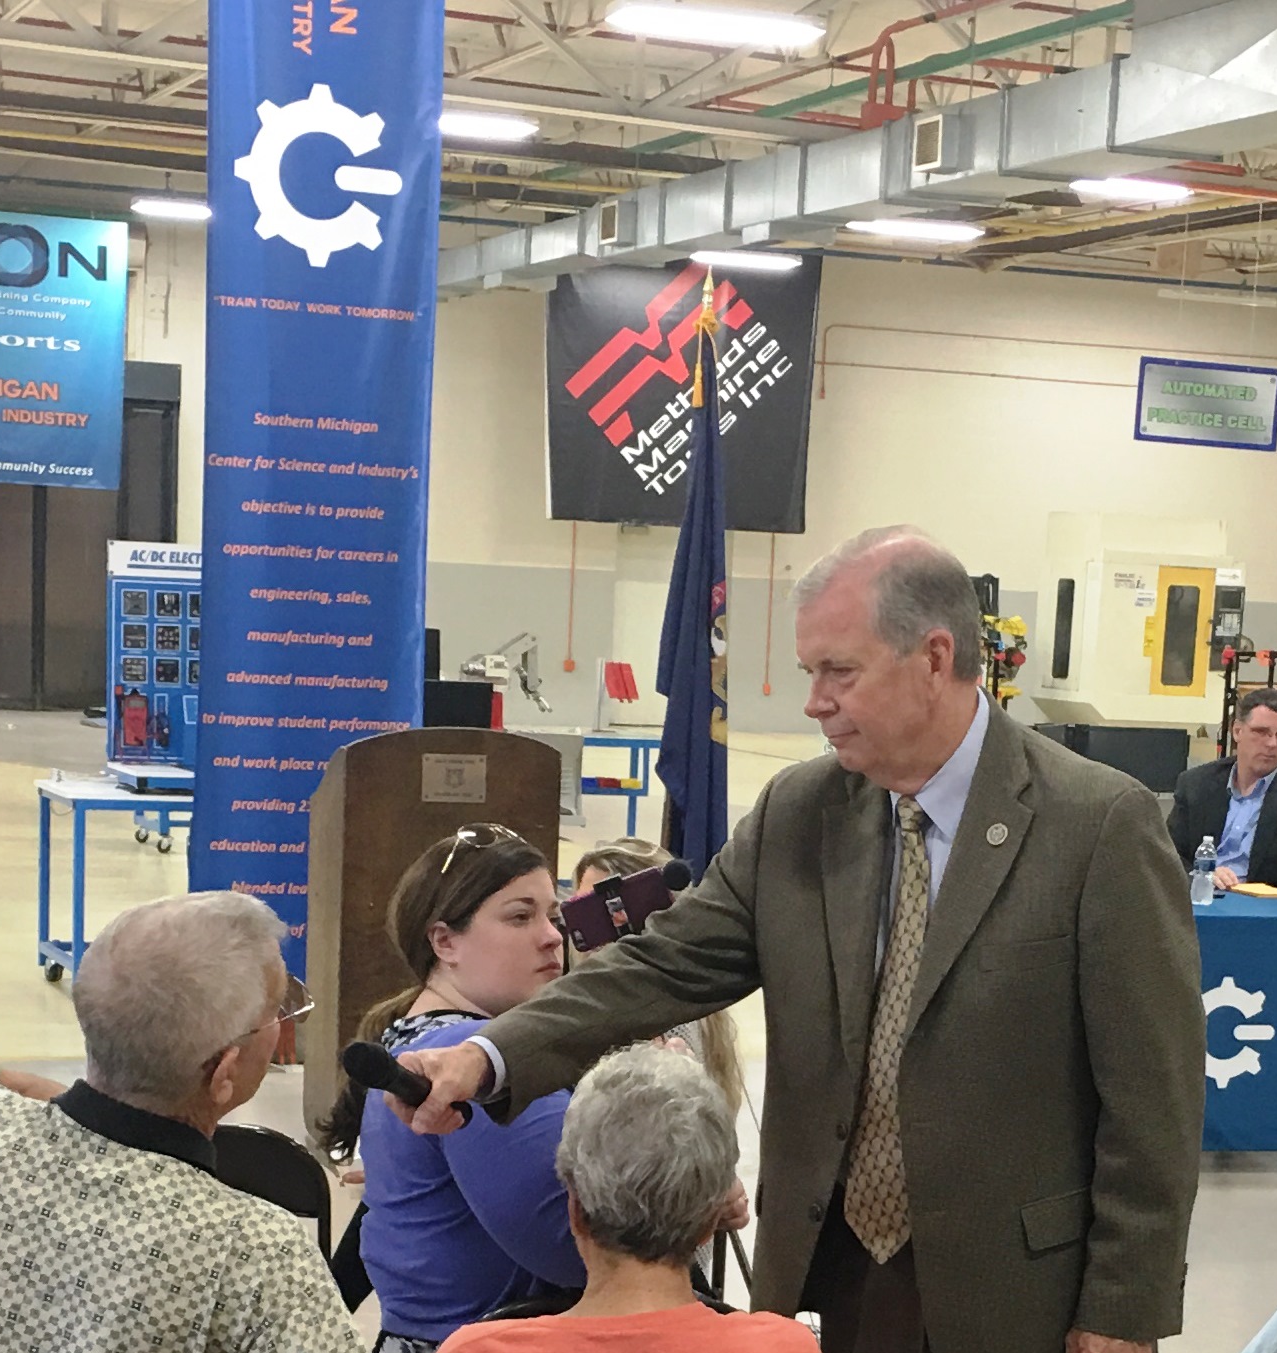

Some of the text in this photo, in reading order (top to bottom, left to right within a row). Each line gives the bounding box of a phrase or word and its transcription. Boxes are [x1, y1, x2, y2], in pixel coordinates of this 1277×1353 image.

[33, 293, 92, 308] Company
[307, 302, 342, 316] WORK
[620, 322, 767, 464] Methds
[1161, 380, 1258, 401] AUTOMATED
[2, 408, 89, 428] INDUSTRY
[634, 338, 780, 482] Maine
[1146, 406, 1267, 432] PRACTICE CELL
[253, 412, 379, 435] Southern Michigan
[644, 355, 793, 495] Tos Inc
[48, 462, 93, 477] Success
[207, 453, 252, 468] Center
[254, 455, 276, 471] for
[278, 457, 326, 473] Science
[329, 462, 354, 475] and
[241, 499, 385, 520] objective is to provide
[130, 549, 166, 564] AC/DC
[222, 543, 399, 563] opportunities for careers in
[249, 587, 372, 605] engineering, sales,
[247, 630, 373, 648] manufacturing and
[226, 671, 388, 692] advanced manufacturing
[202, 712, 410, 733] to improve student performance
[213, 755, 240, 768] and
[243, 755, 277, 769] work
[279, 757, 314, 772] place
[231, 799, 296, 814] providing
[210, 839, 305, 853] education and
[231, 881, 285, 895] blended
